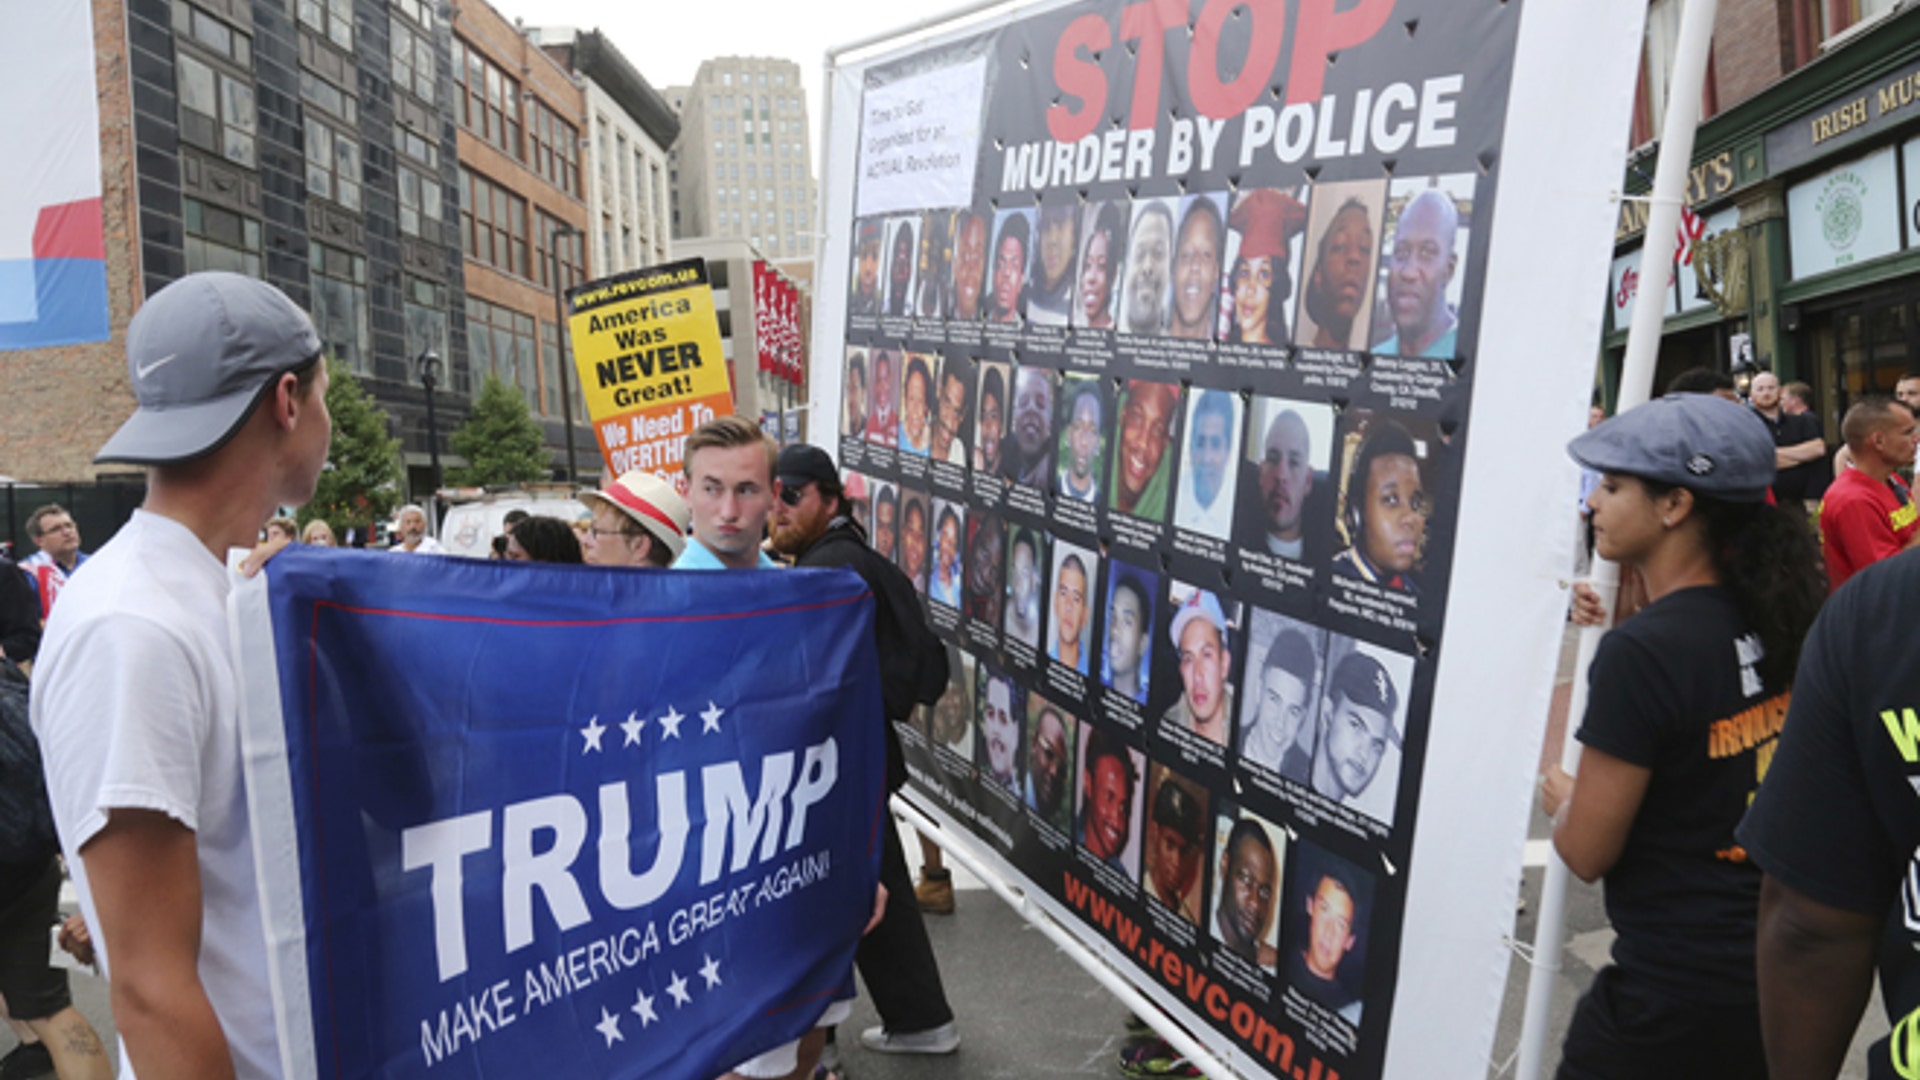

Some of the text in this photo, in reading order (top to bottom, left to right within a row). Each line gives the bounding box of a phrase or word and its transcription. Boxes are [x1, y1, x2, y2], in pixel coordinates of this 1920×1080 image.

[1046, 0, 1397, 144] STOP
[1002, 74, 1464, 192] MURDER BY POLICE
[1812, 97, 1867, 145] IRISH
[573, 268, 698, 307] www.revcom.us
[589, 298, 691, 335] America
[614, 326, 668, 351] Was
[596, 341, 703, 388] NEVER
[614, 374, 693, 408] Great!
[601, 402, 714, 449] We Need To
[610, 435, 688, 475] OVERTH
[402, 736, 839, 983] TRUMP
[420, 850, 830, 1068] MAKE AMERICA GREAT AGAIN!
